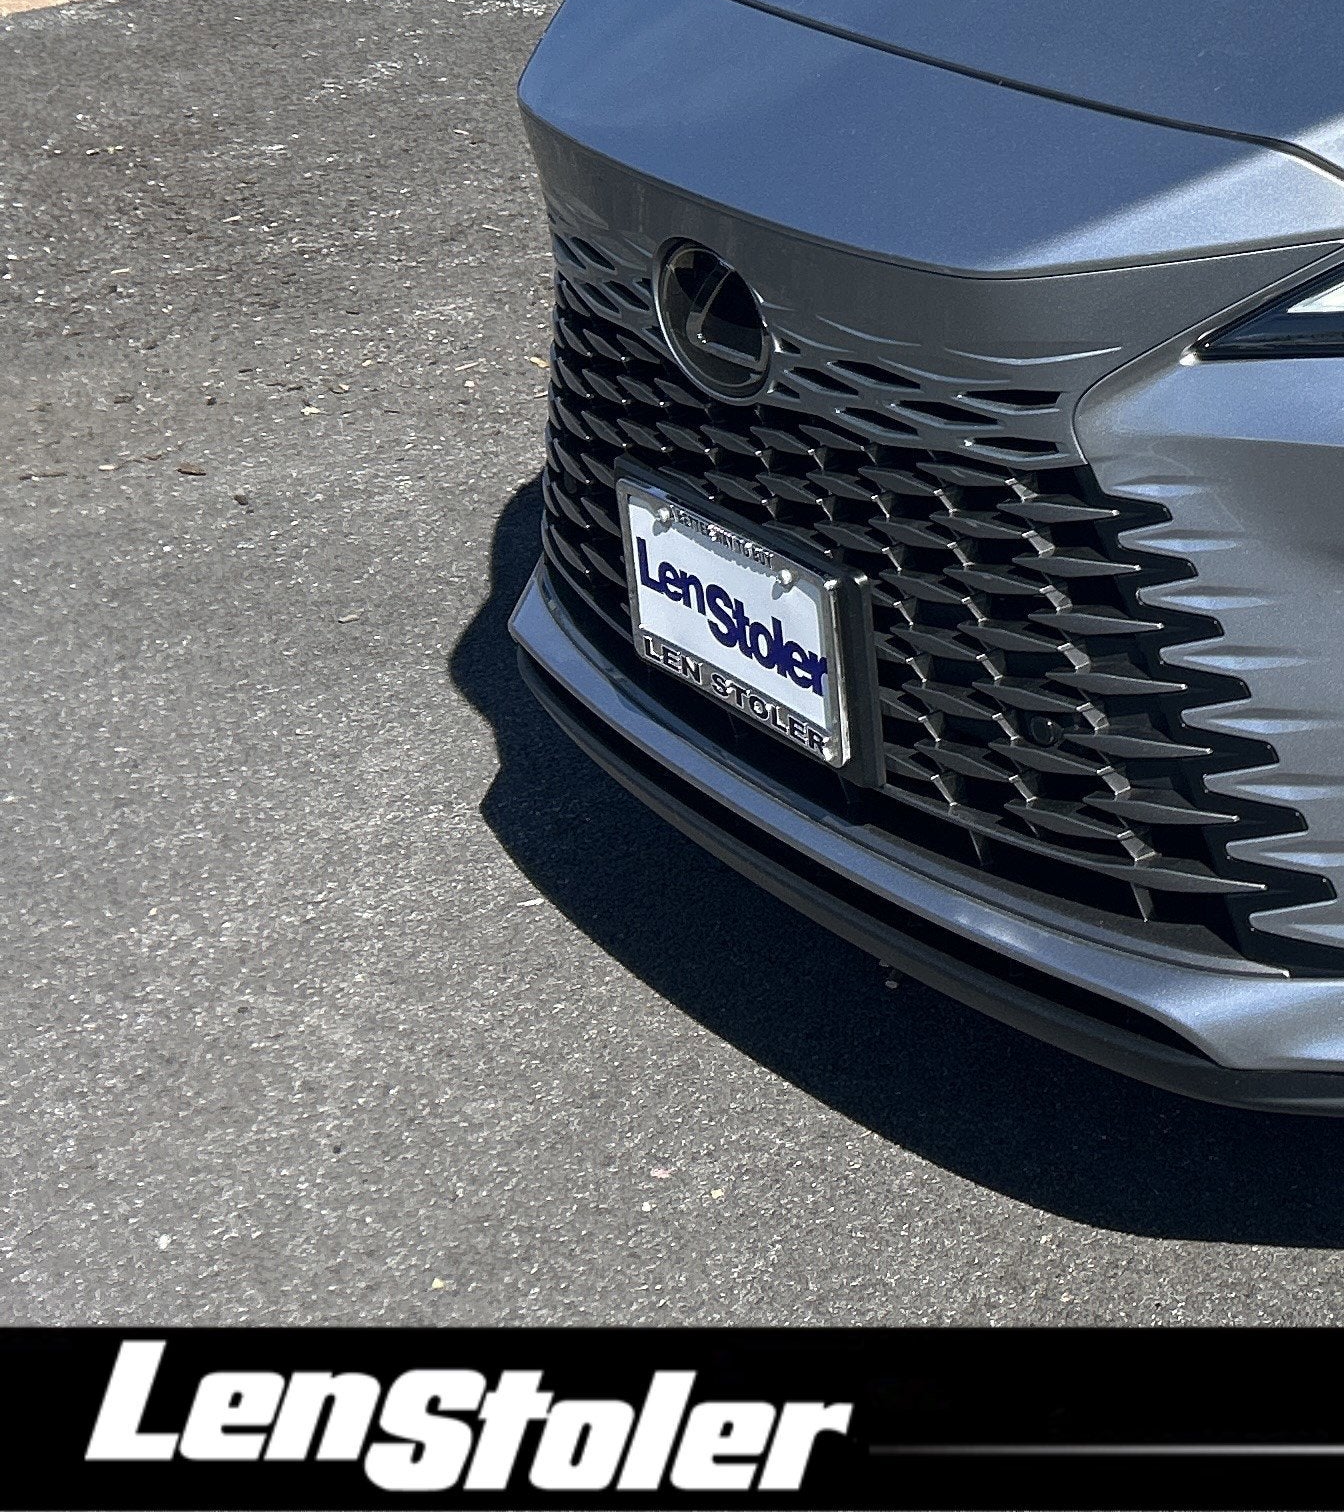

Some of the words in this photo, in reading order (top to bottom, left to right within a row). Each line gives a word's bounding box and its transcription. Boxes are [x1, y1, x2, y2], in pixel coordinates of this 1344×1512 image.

[636, 536, 828, 697] LenStoler
[643, 635, 703, 685] LEN
[711, 673, 828, 761] STOLER
